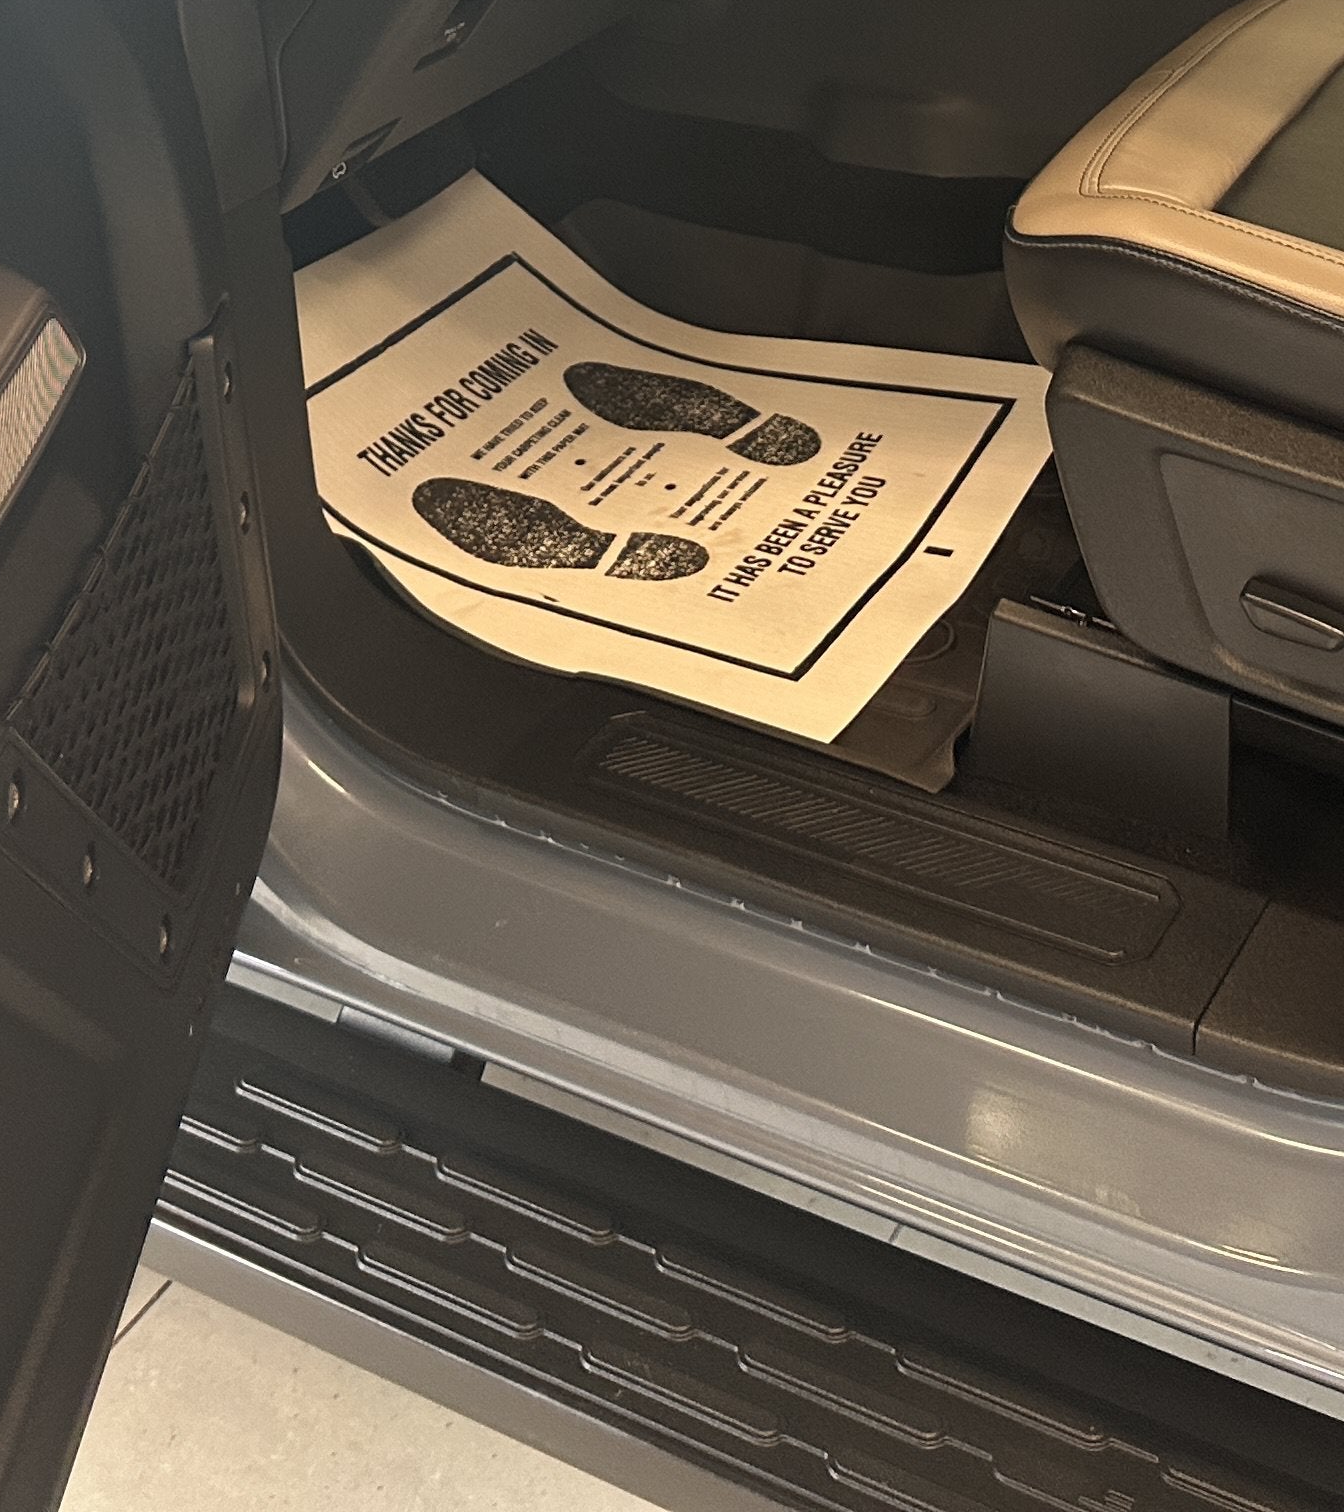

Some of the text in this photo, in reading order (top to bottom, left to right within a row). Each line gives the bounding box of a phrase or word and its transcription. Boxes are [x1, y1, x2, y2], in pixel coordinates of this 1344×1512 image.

[356, 328, 559, 477] THANKS FOR COMING IN
[519, 410, 534, 421] TO
[707, 431, 883, 603] IT HAS BEEN A PLEASURE
[777, 475, 887, 576] TO SERVE YOU
